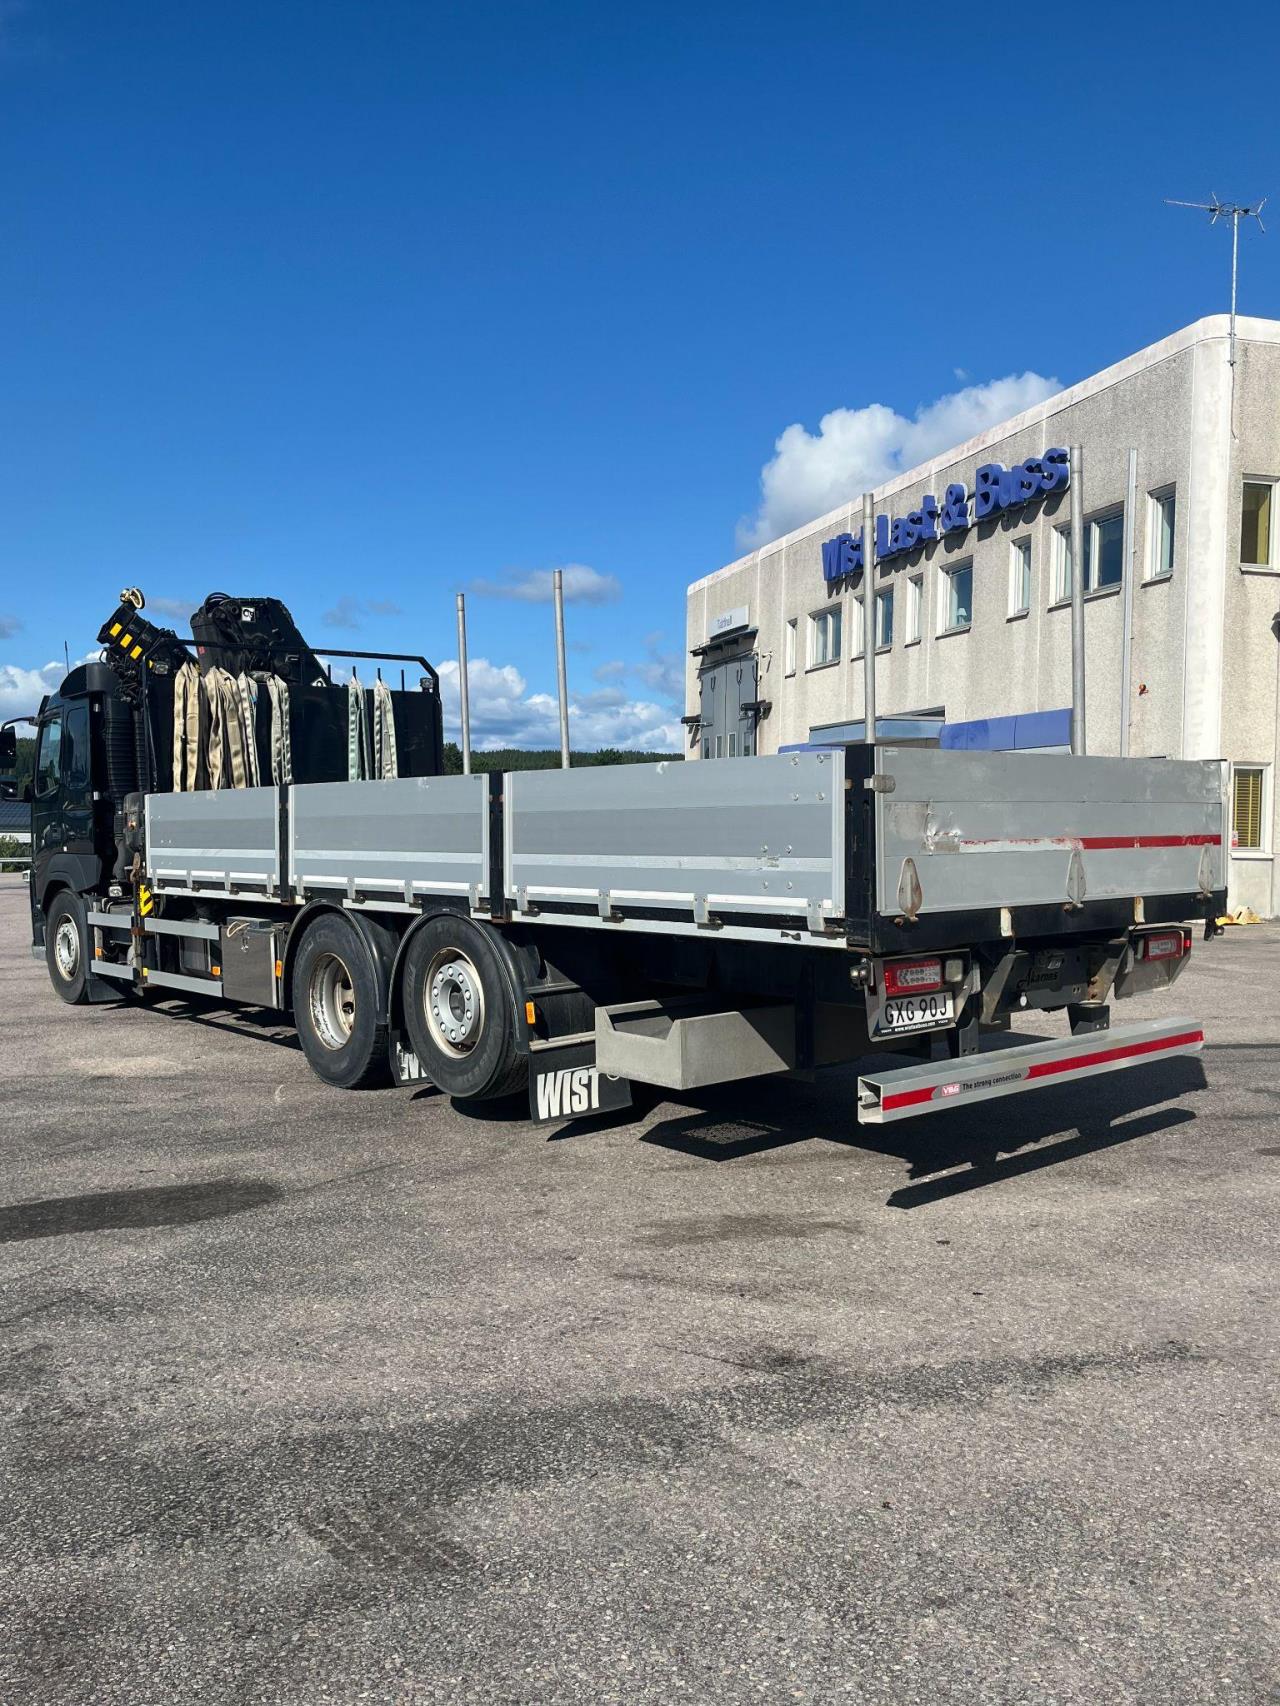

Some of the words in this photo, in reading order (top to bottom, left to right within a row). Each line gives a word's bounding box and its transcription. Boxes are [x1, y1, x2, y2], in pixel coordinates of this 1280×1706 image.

[877, 495, 939, 559] Last
[941, 483, 971, 531] &
[975, 447, 1070, 519] Buss
[884, 1001, 915, 1024] GXG
[919, 995, 947, 1020] 90J
[537, 1066, 600, 1120] WIST
[963, 1083, 973, 1091] The
[974, 1079, 992, 1088] strong
[992, 1073, 1021, 1084] connection
